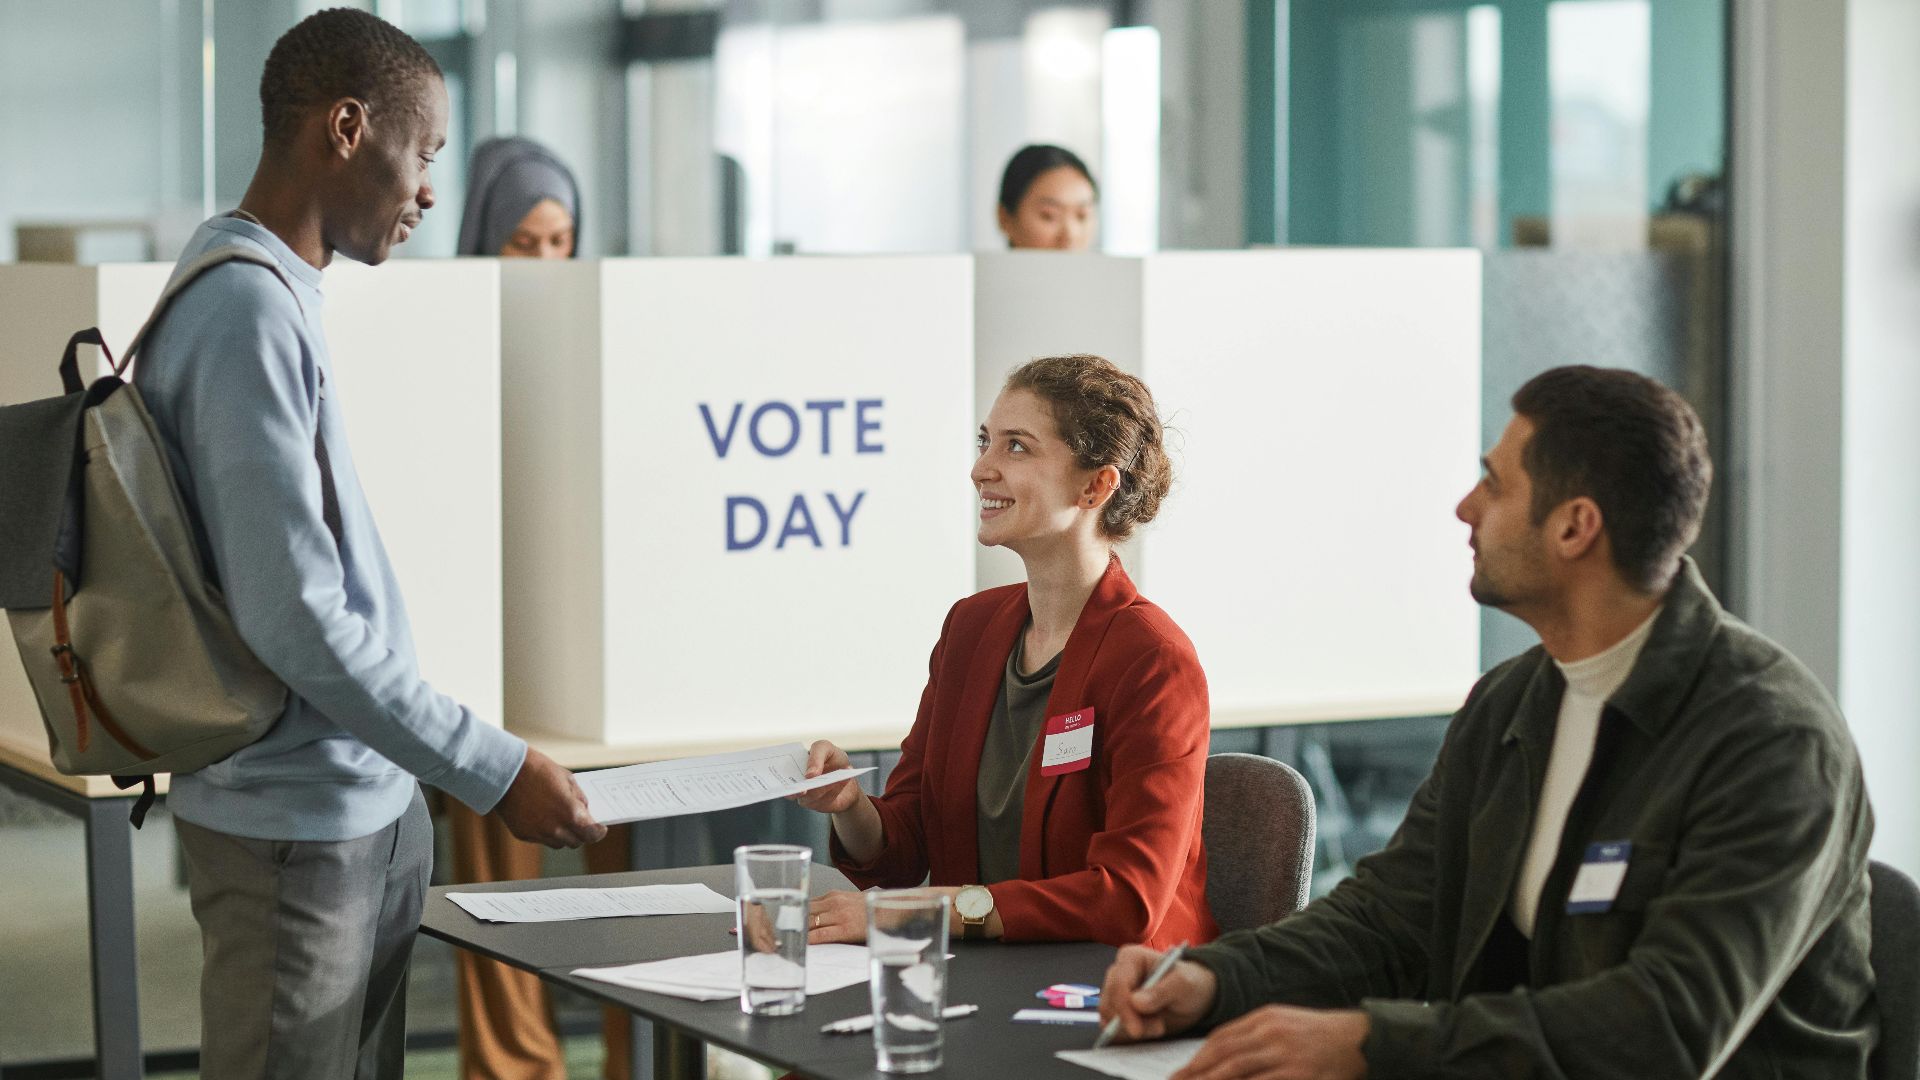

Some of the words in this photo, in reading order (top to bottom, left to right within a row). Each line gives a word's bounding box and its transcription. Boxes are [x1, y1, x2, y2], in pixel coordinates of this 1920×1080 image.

[698, 398, 884, 459] VOTE
[725, 491, 867, 552] DAY
[1065, 714, 1082, 724] HELLO
